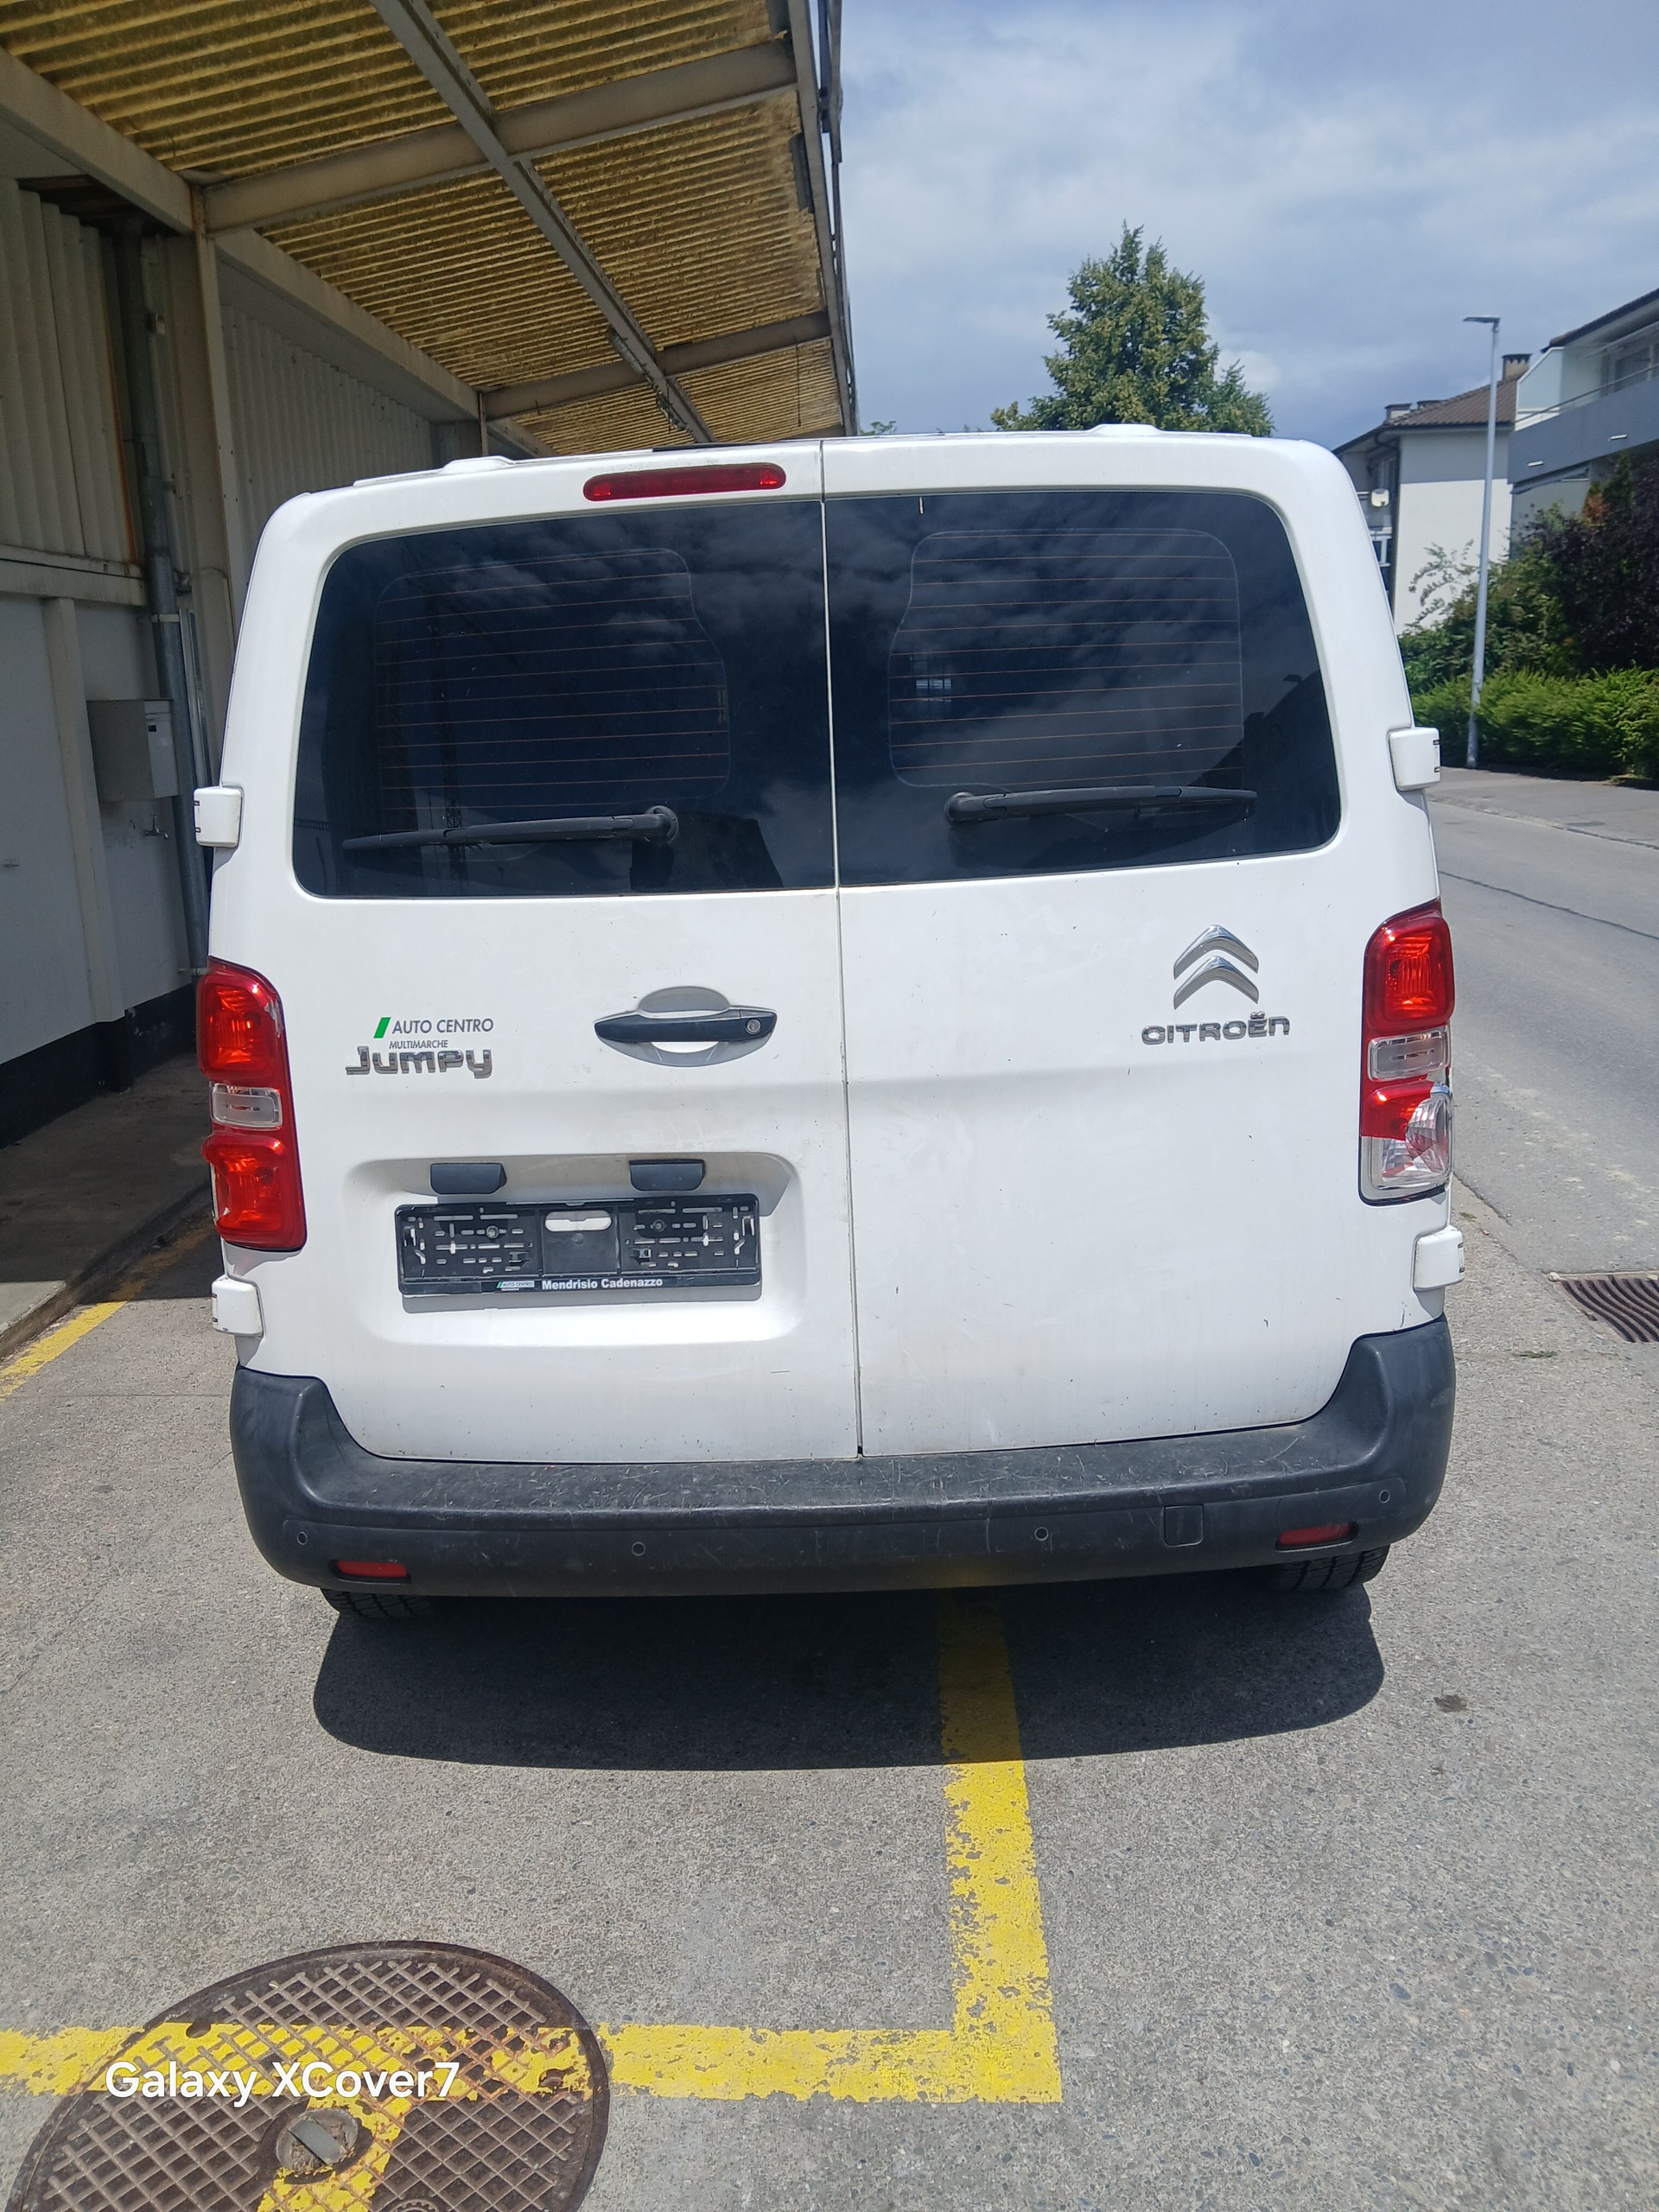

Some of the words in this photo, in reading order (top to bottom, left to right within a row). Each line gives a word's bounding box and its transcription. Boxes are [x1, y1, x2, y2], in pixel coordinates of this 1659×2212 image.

[391, 1020, 432, 1034] AUTO
[436, 1018, 494, 1033] CENTRO
[389, 1039, 448, 1049] MULTIMARCHE
[345, 1046, 493, 1079] Jumpy
[541, 1279, 598, 1290] Mendrisio
[601, 1278, 663, 1288] Cadenazzo
